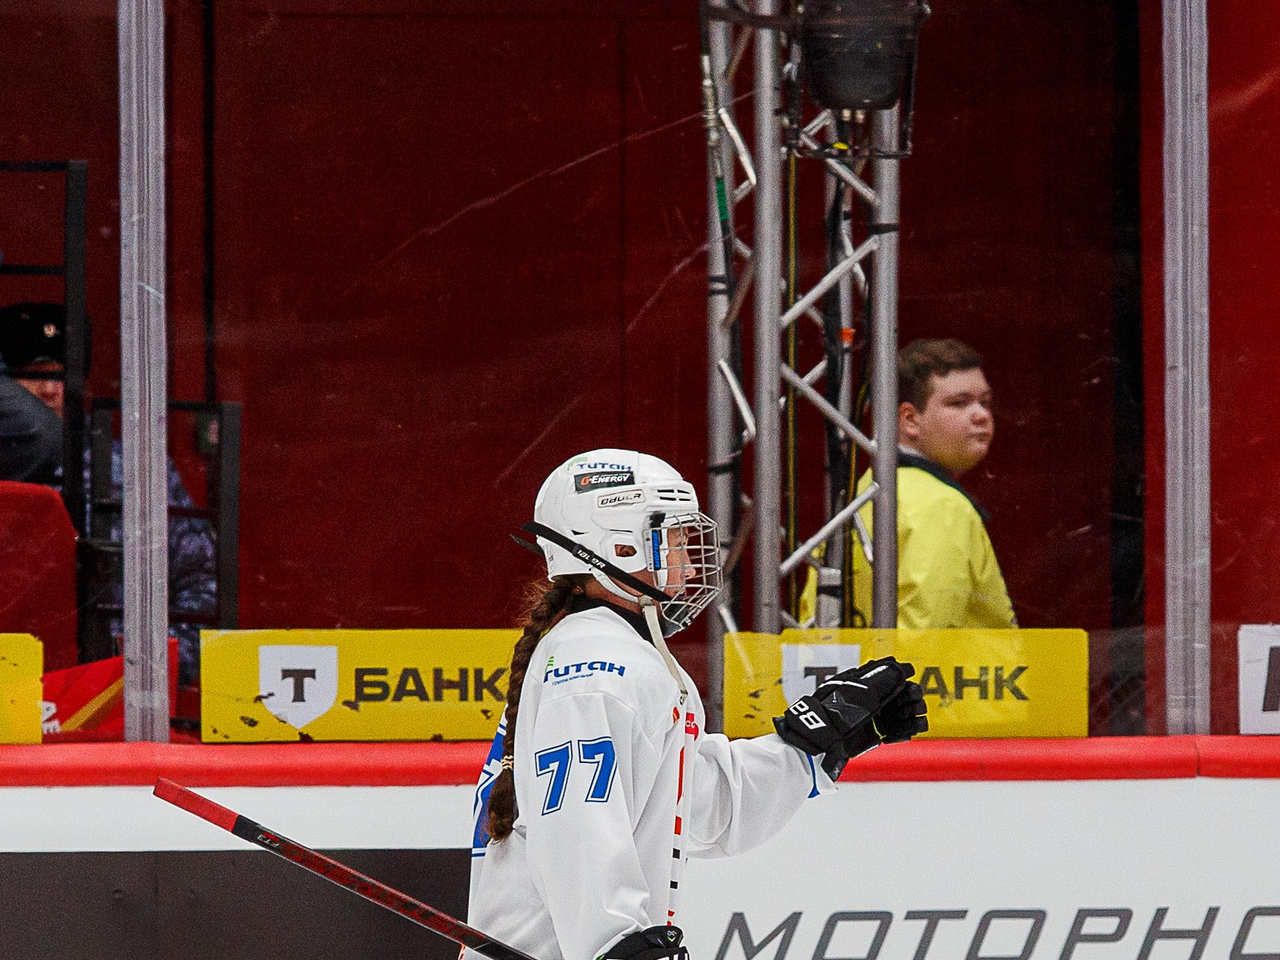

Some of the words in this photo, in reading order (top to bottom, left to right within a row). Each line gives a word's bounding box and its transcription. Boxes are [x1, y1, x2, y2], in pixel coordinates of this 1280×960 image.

[354, 668, 507, 702] БАНК
[920, 666, 1029, 700] АНК
[535, 736, 618, 816] 77
